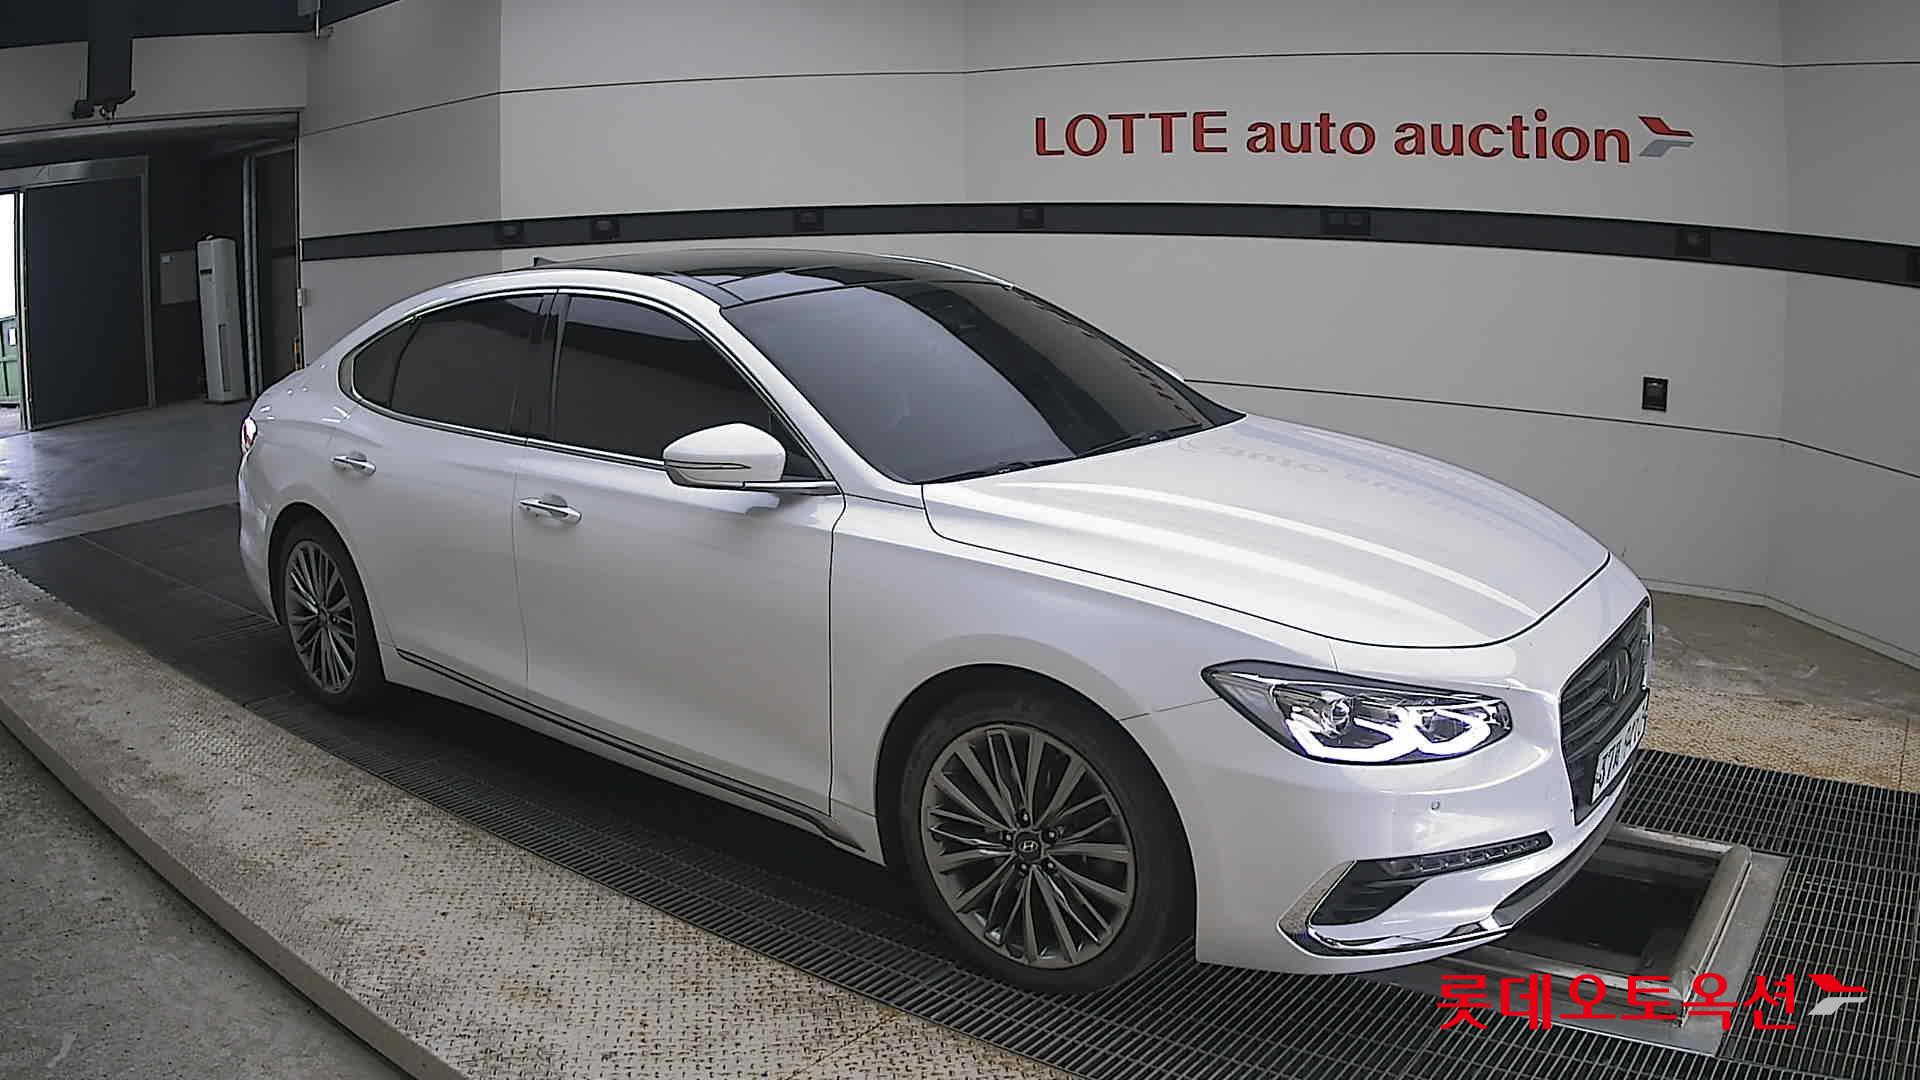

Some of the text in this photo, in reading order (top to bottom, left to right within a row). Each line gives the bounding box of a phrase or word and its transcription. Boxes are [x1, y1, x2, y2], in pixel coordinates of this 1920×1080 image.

[1034, 108, 1632, 163] LOTTE auto auction
